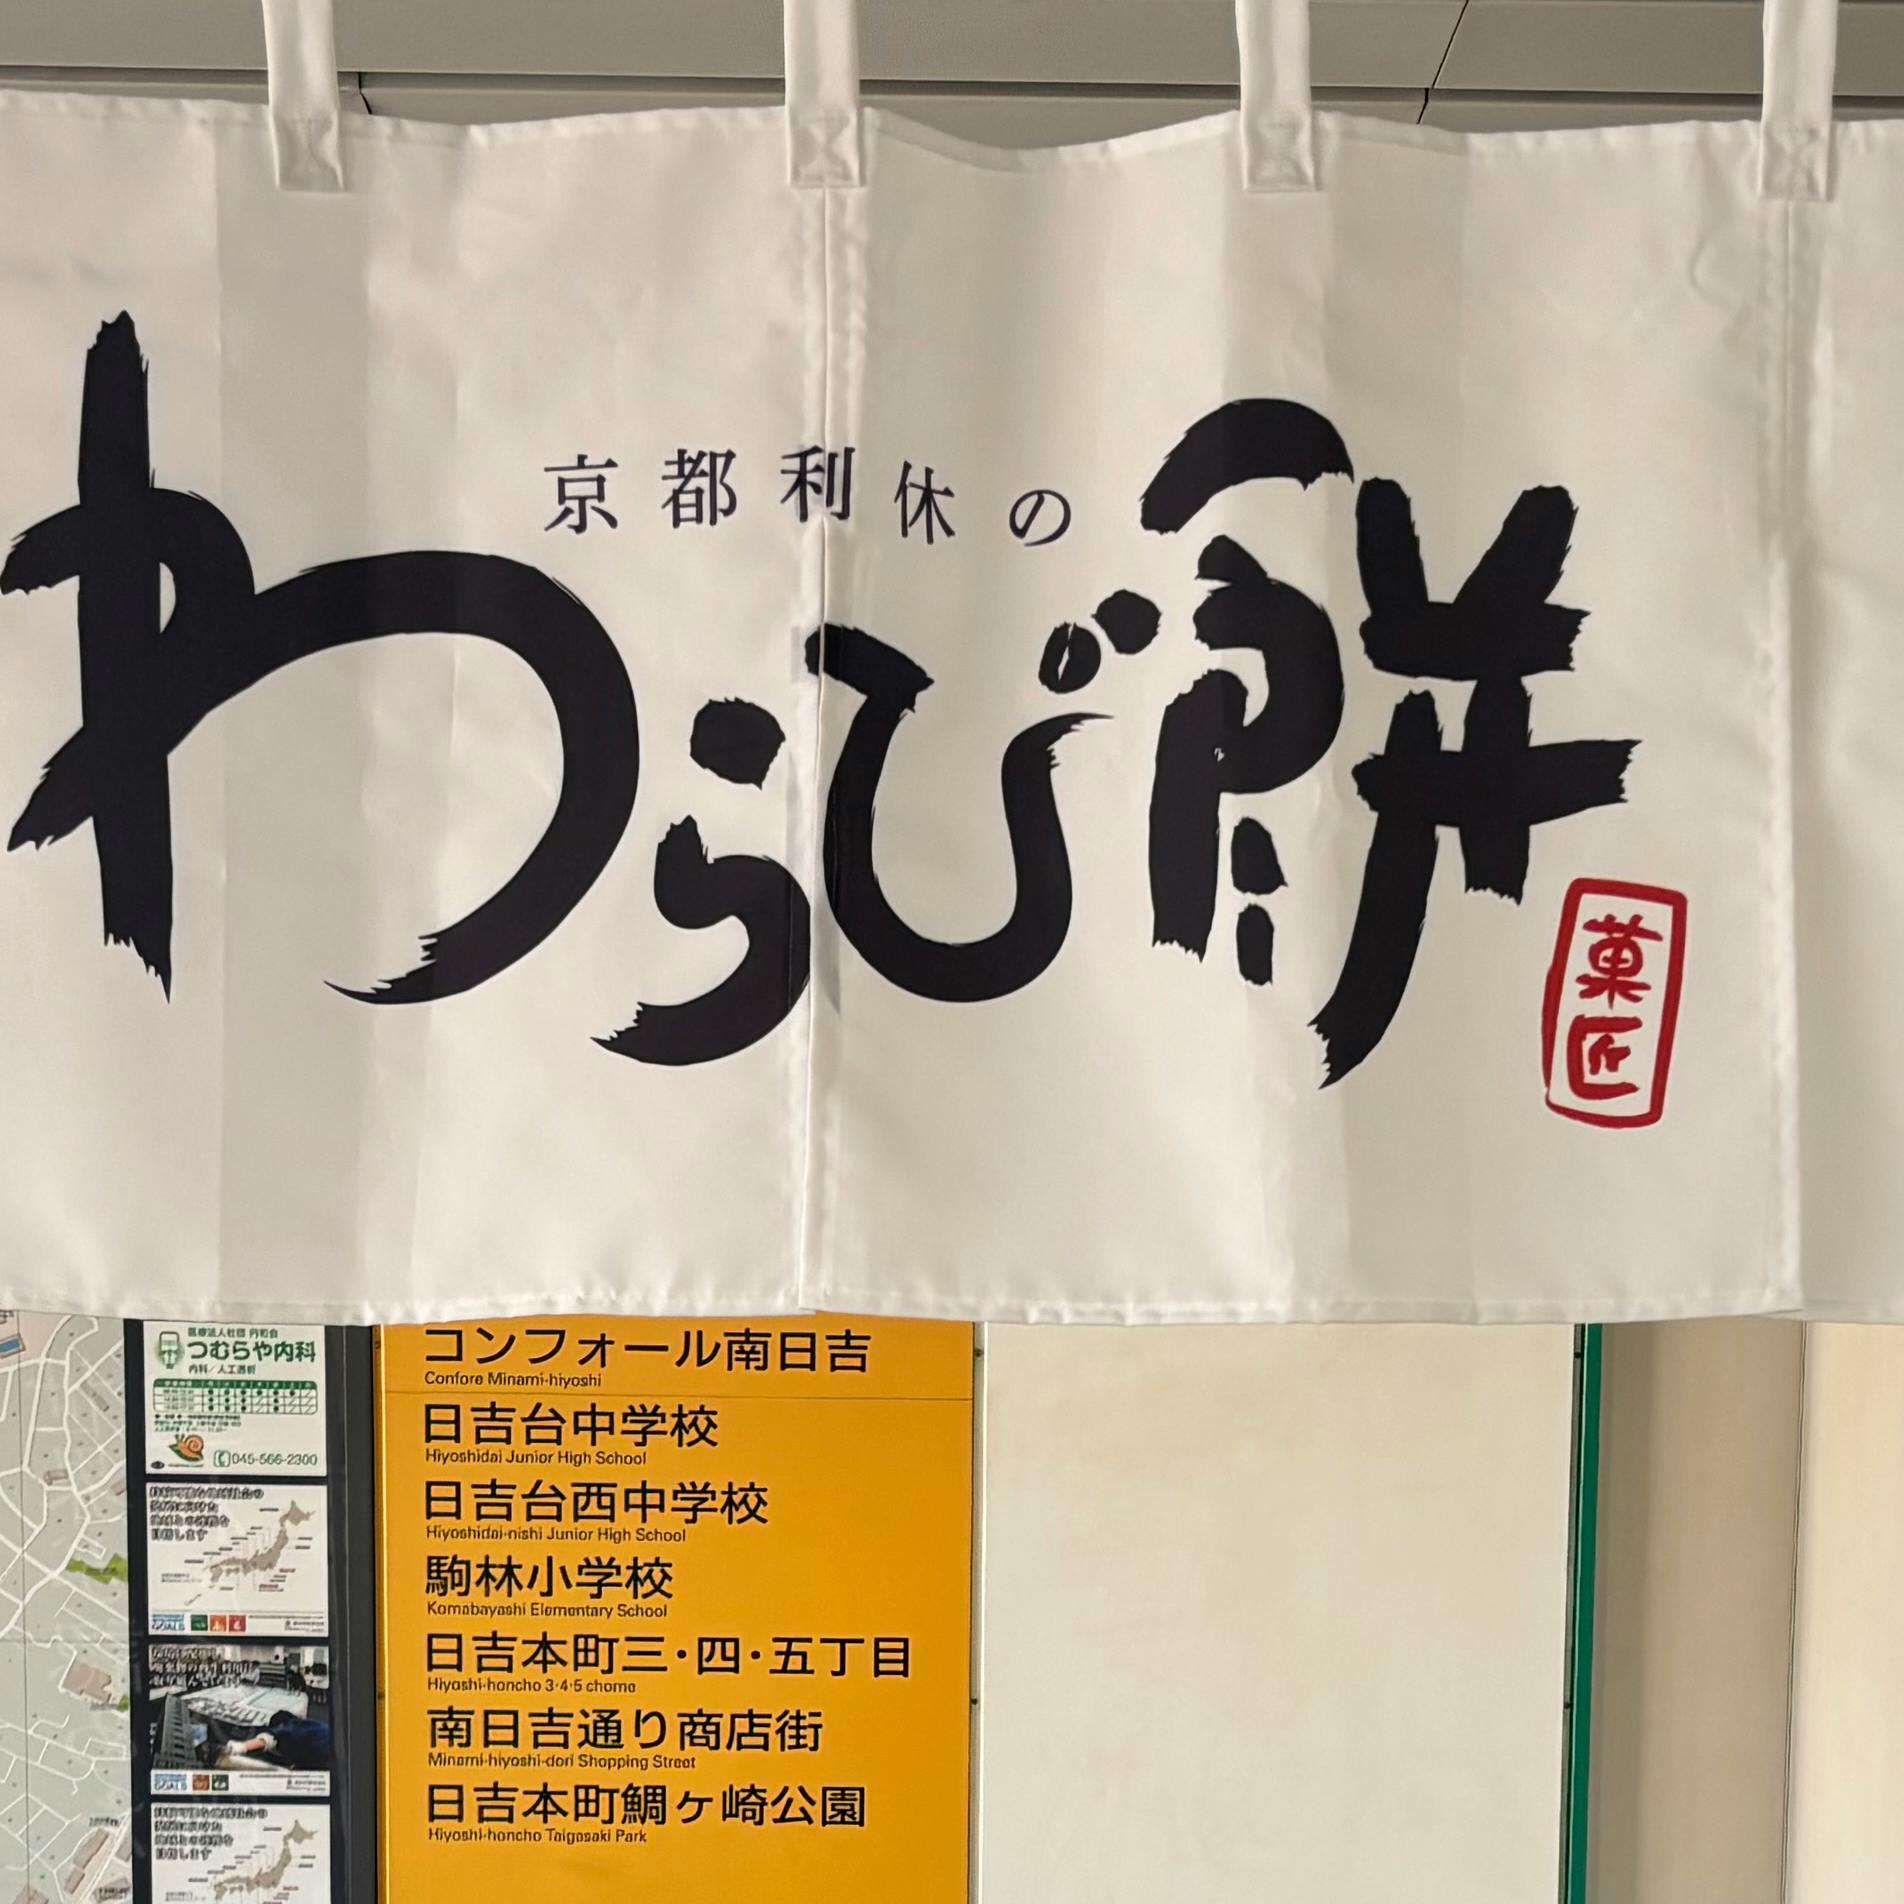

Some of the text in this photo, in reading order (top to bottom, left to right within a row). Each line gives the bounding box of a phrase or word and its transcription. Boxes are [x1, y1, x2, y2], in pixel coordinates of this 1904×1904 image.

[543, 443, 1074, 548] 京都利休の
[187, 1340, 316, 1362] つむらや内科
[423, 1328, 872, 1373] コンフォール南日吉
[424, 1372, 602, 1388] Confore Minami-hiyoshi
[423, 1402, 719, 1447] 日吉台中学校
[426, 1450, 646, 1467] Hiyoshidai Junior High School
[425, 1479, 768, 1524] 日吉台西中学校
[426, 1527, 686, 1544] Hiyoshidai-nishi Junior High School
[425, 1555, 673, 1599] 駒林小学校
[427, 1603, 668, 1619] Komabayashi Elementary School
[425, 1631, 911, 1678] 日吉本町三・四・五丁目
[427, 1678, 542, 1693] Hiyoshi-honcho
[586, 1680, 636, 1693] chome
[427, 1707, 822, 1752] 南日吉通り商店街
[427, 1753, 696, 1770] Minami-hiyoshi-dori Shopping Street
[427, 1782, 866, 1827] 日吉本町鯛ヶ崎公園
[427, 1828, 647, 1845] Hiyoshi-honcho Taigasaki Park
